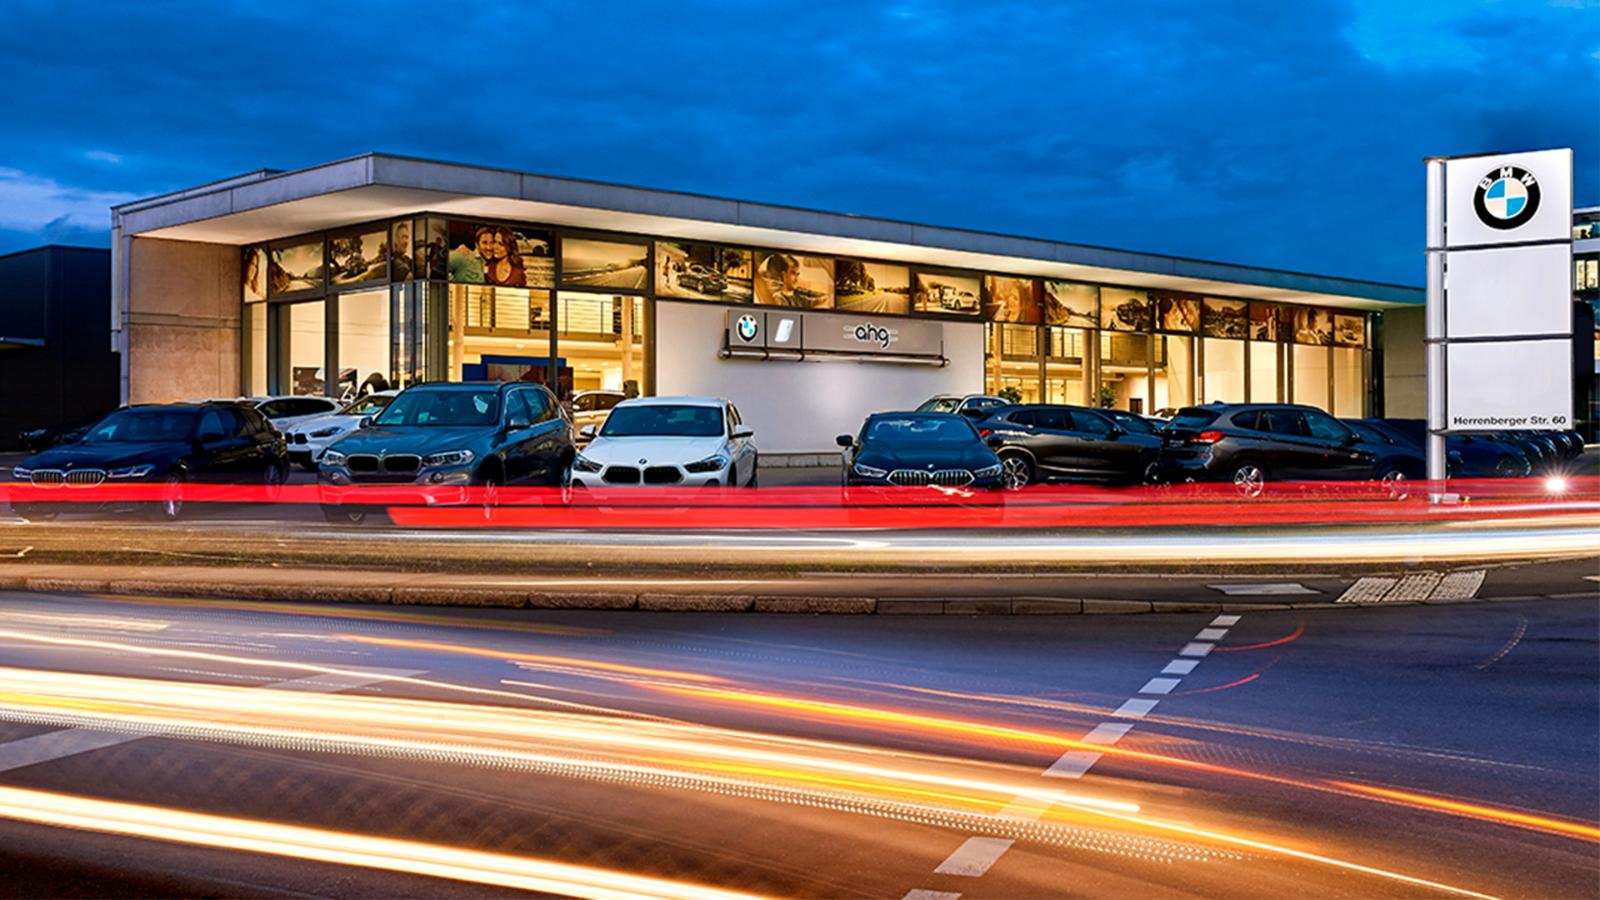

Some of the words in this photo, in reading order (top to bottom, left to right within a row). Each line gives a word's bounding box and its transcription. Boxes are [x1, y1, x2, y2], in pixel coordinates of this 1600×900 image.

[1479, 166, 1536, 190] BMW
[854, 323, 890, 349] ahg
[1453, 416, 1527, 427] Herrenberger
[1530, 415, 1549, 425] Str.
[1552, 415, 1567, 425] 60
